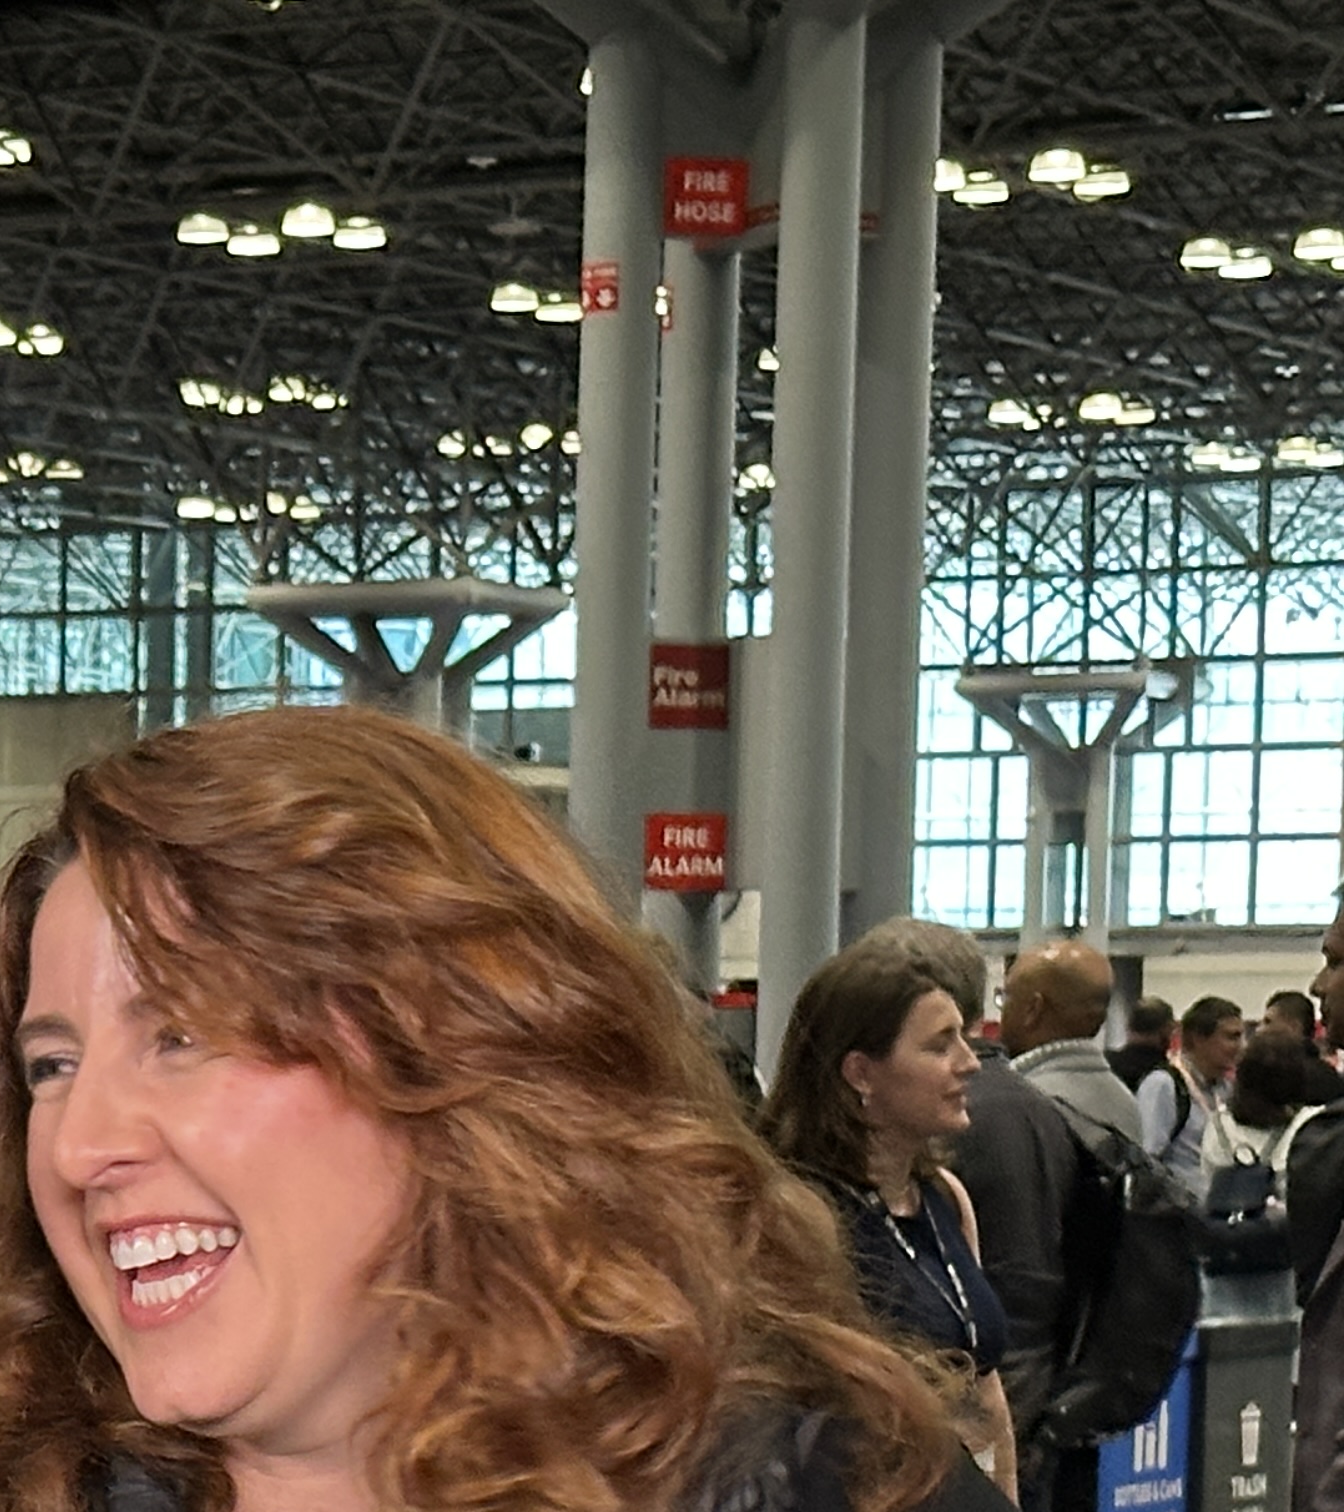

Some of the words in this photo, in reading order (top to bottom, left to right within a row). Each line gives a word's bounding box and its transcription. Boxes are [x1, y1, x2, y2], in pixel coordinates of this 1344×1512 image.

[684, 170, 729, 193] FIRE
[675, 201, 735, 223] HOSE
[654, 666, 699, 687] Fire
[653, 687, 725, 708] Alarm
[663, 826, 709, 848] FIRE
[649, 856, 724, 877] ALARM
